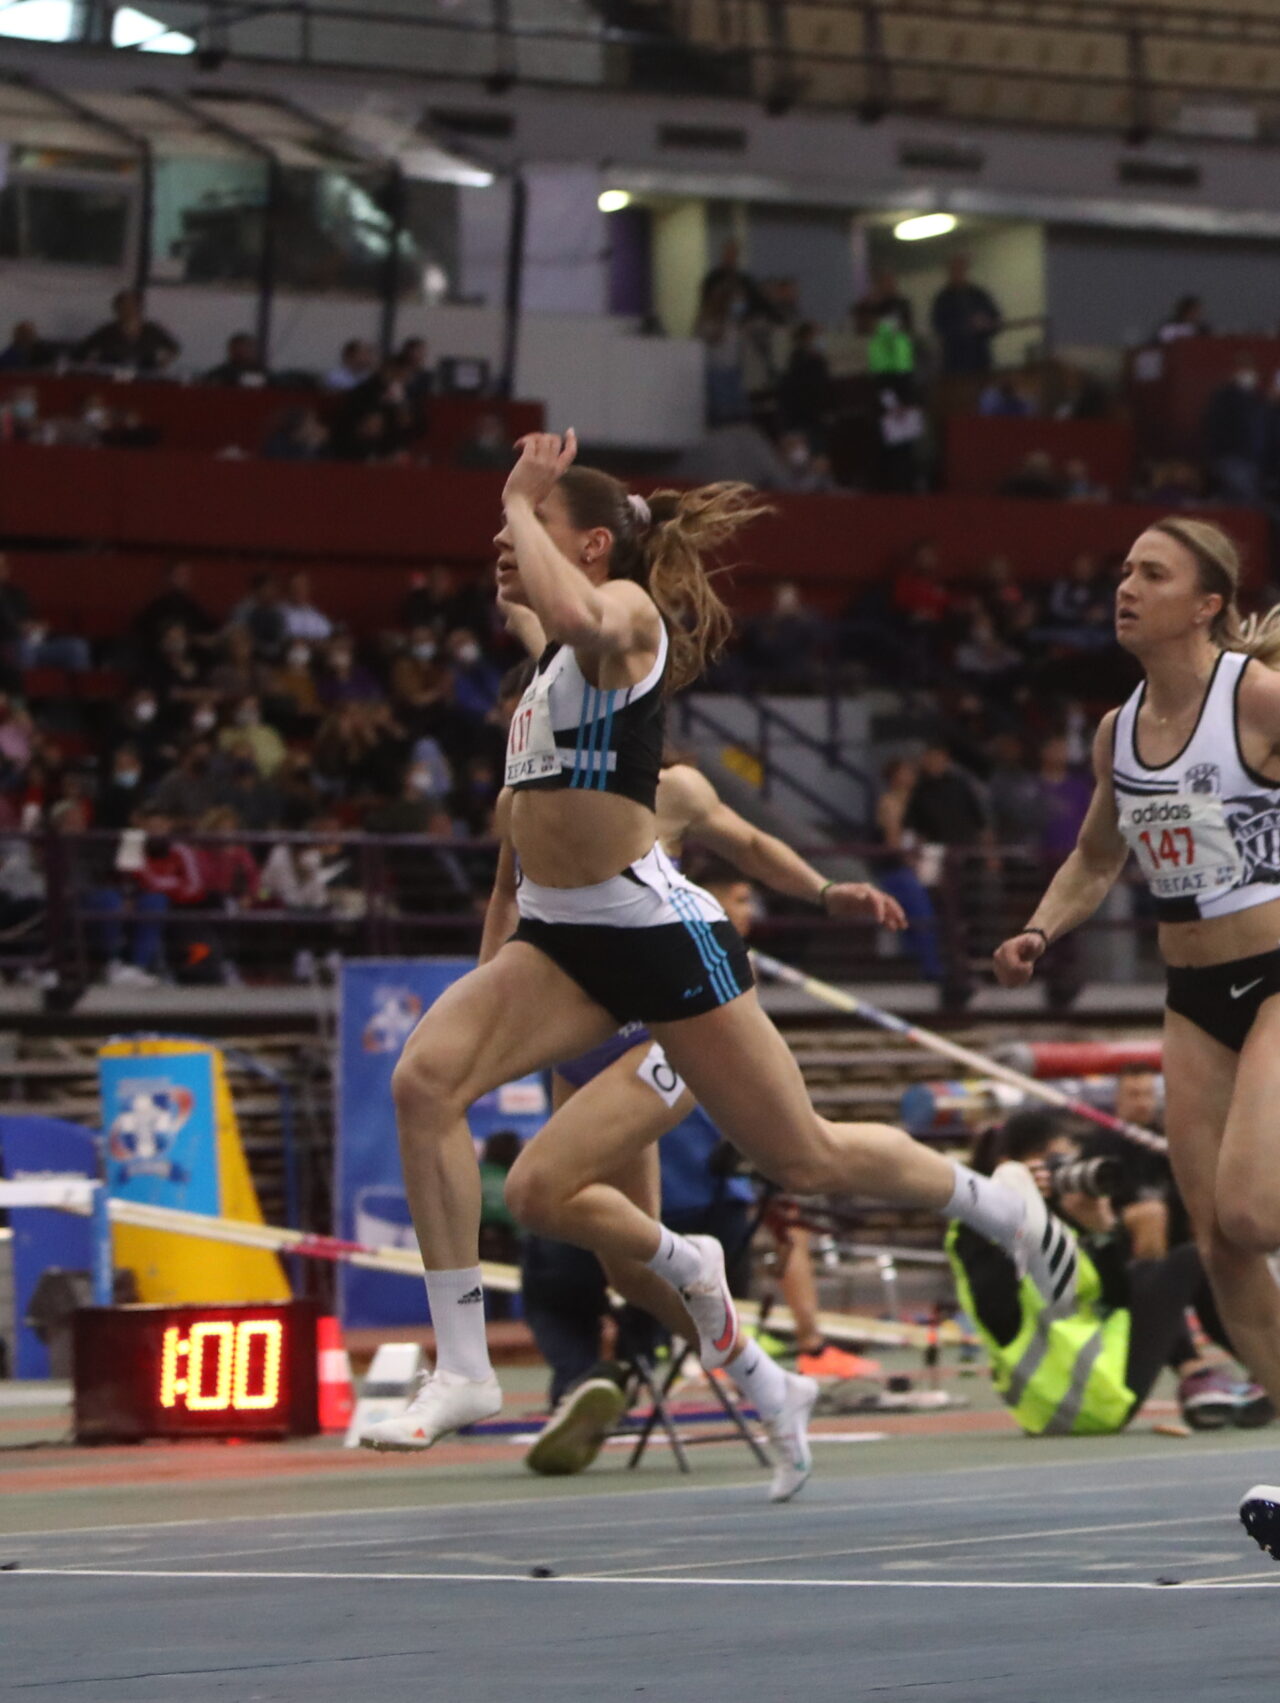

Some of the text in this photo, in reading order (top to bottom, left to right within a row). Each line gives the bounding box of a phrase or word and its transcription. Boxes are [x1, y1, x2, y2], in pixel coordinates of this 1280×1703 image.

[1131, 800, 1192, 825] adidas
[1139, 826, 1195, 870] 147
[160, 1318, 284, 1411] 1:00
